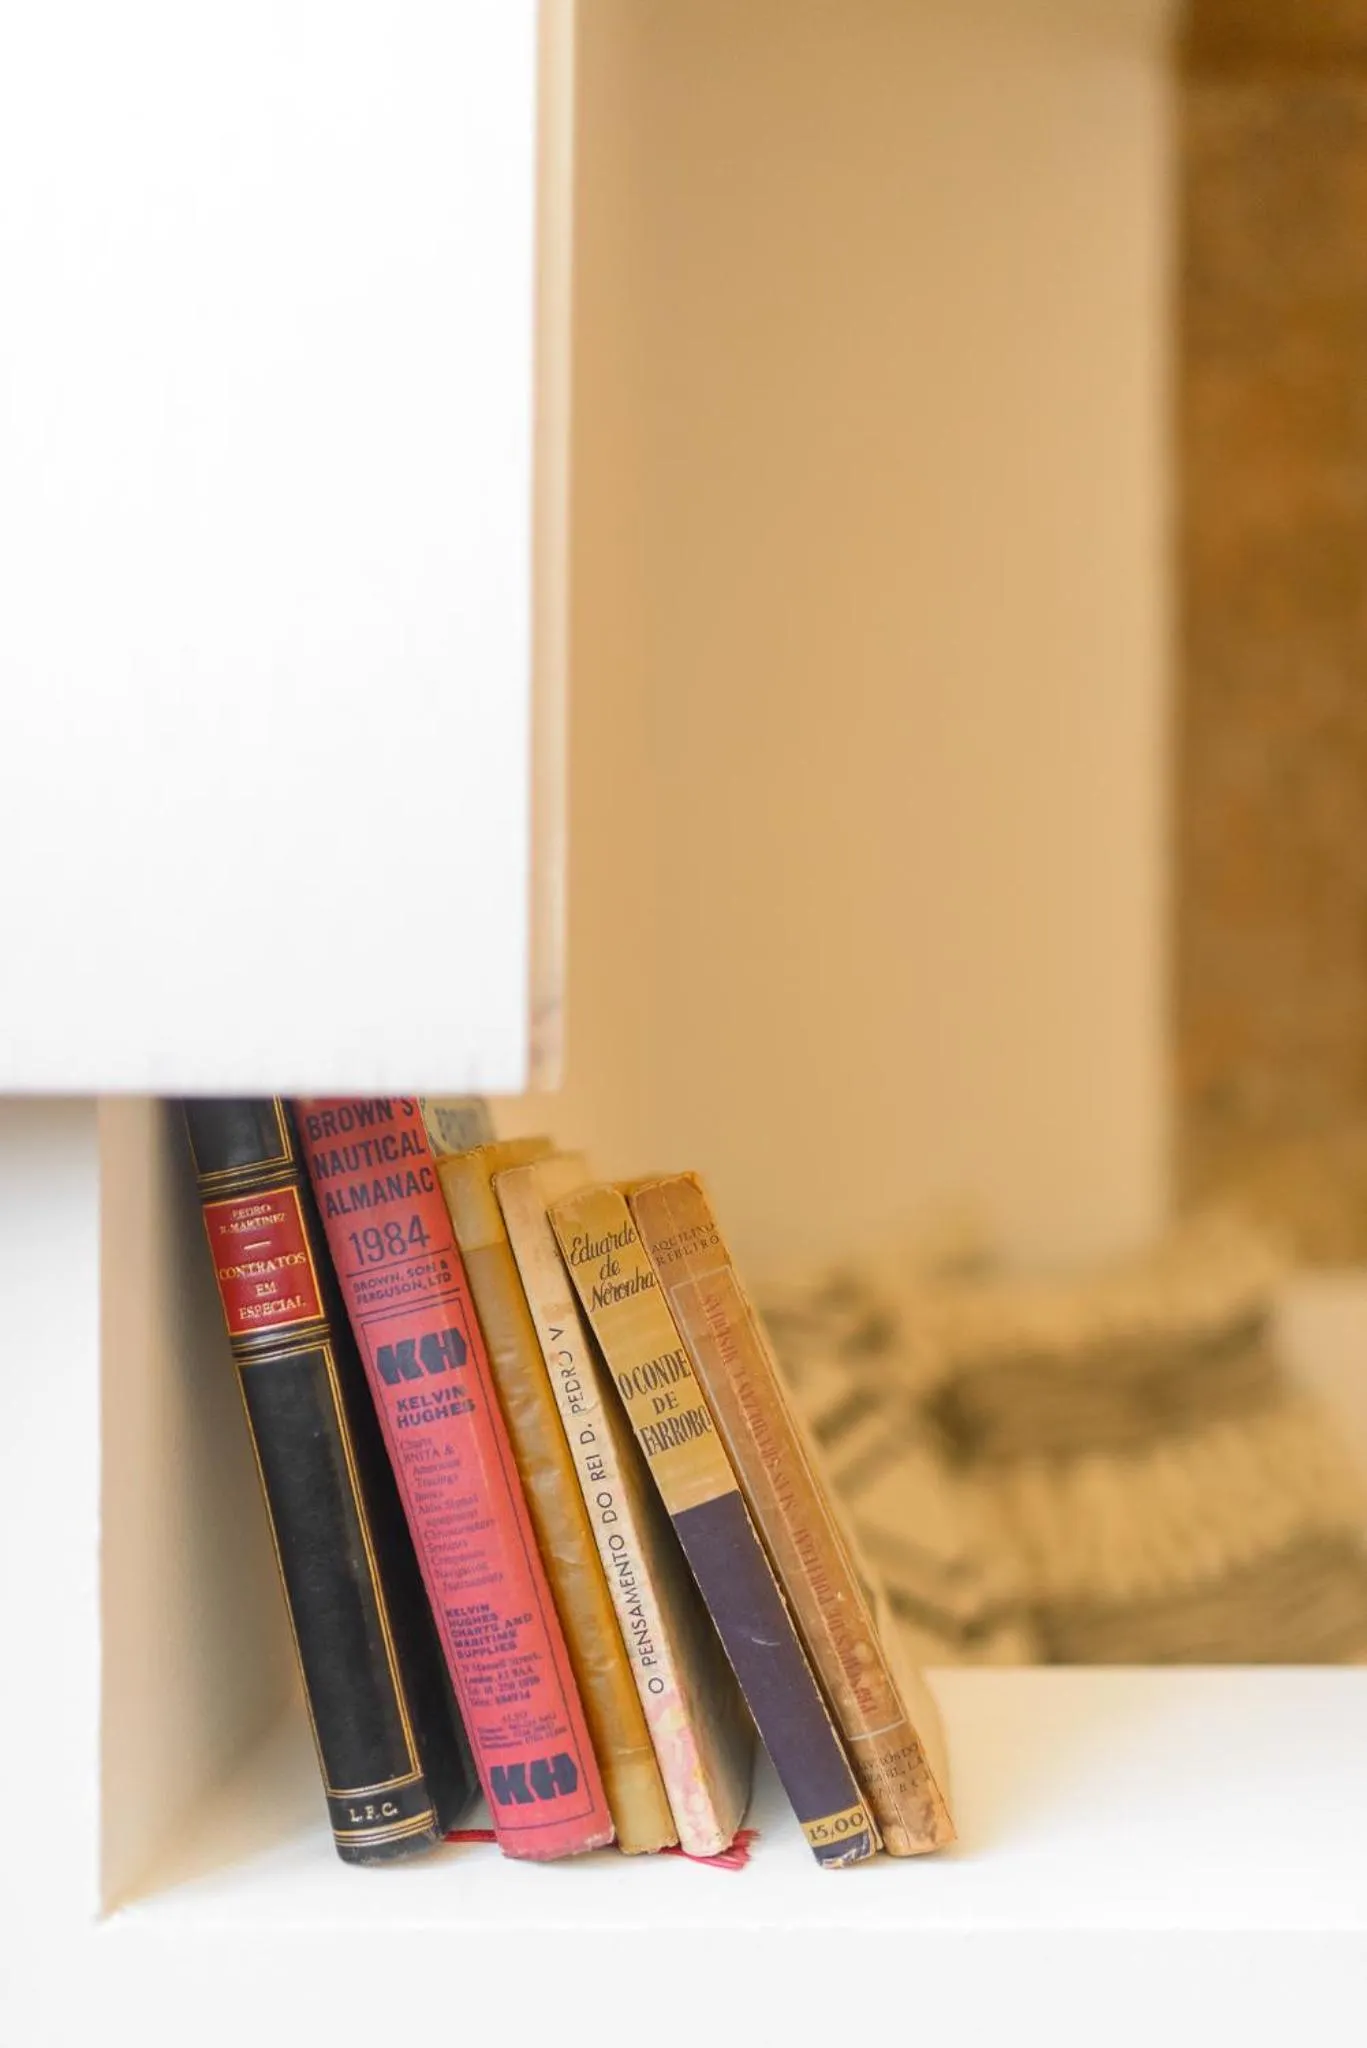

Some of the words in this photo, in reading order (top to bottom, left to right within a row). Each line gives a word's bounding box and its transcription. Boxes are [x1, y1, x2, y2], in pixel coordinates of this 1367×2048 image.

[306, 1096, 414, 1142] BROWN'S
[312, 1129, 426, 1180] NAUTICAL
[325, 1167, 434, 1219] ALMANAC
[232, 1203, 271, 1218] PEDRO
[348, 1214, 430, 1266] 1984
[219, 1252, 306, 1280] CONTRATOS
[407, 1262, 437, 1277] SON
[600, 1254, 621, 1281] de
[255, 1281, 278, 1298] EM
[590, 1267, 656, 1313] Noronha
[239, 1295, 306, 1320] ESPECIAL
[548, 1327, 565, 1341] V
[559, 1350, 585, 1414] PEDRO
[397, 1386, 468, 1413] KELVIN
[652, 1391, 679, 1415] DE
[397, 1399, 475, 1429] HUGHES
[580, 1422, 597, 1445] D.
[585, 1454, 607, 1482] REI
[597, 1491, 618, 1524] DO
[446, 1604, 489, 1618] KELVIN
[608, 1534, 657, 1667] PENSAMENTO
[505, 1612, 533, 1629] AND
[648, 1677, 665, 1694] O
[808, 1812, 865, 1842] 15,00
